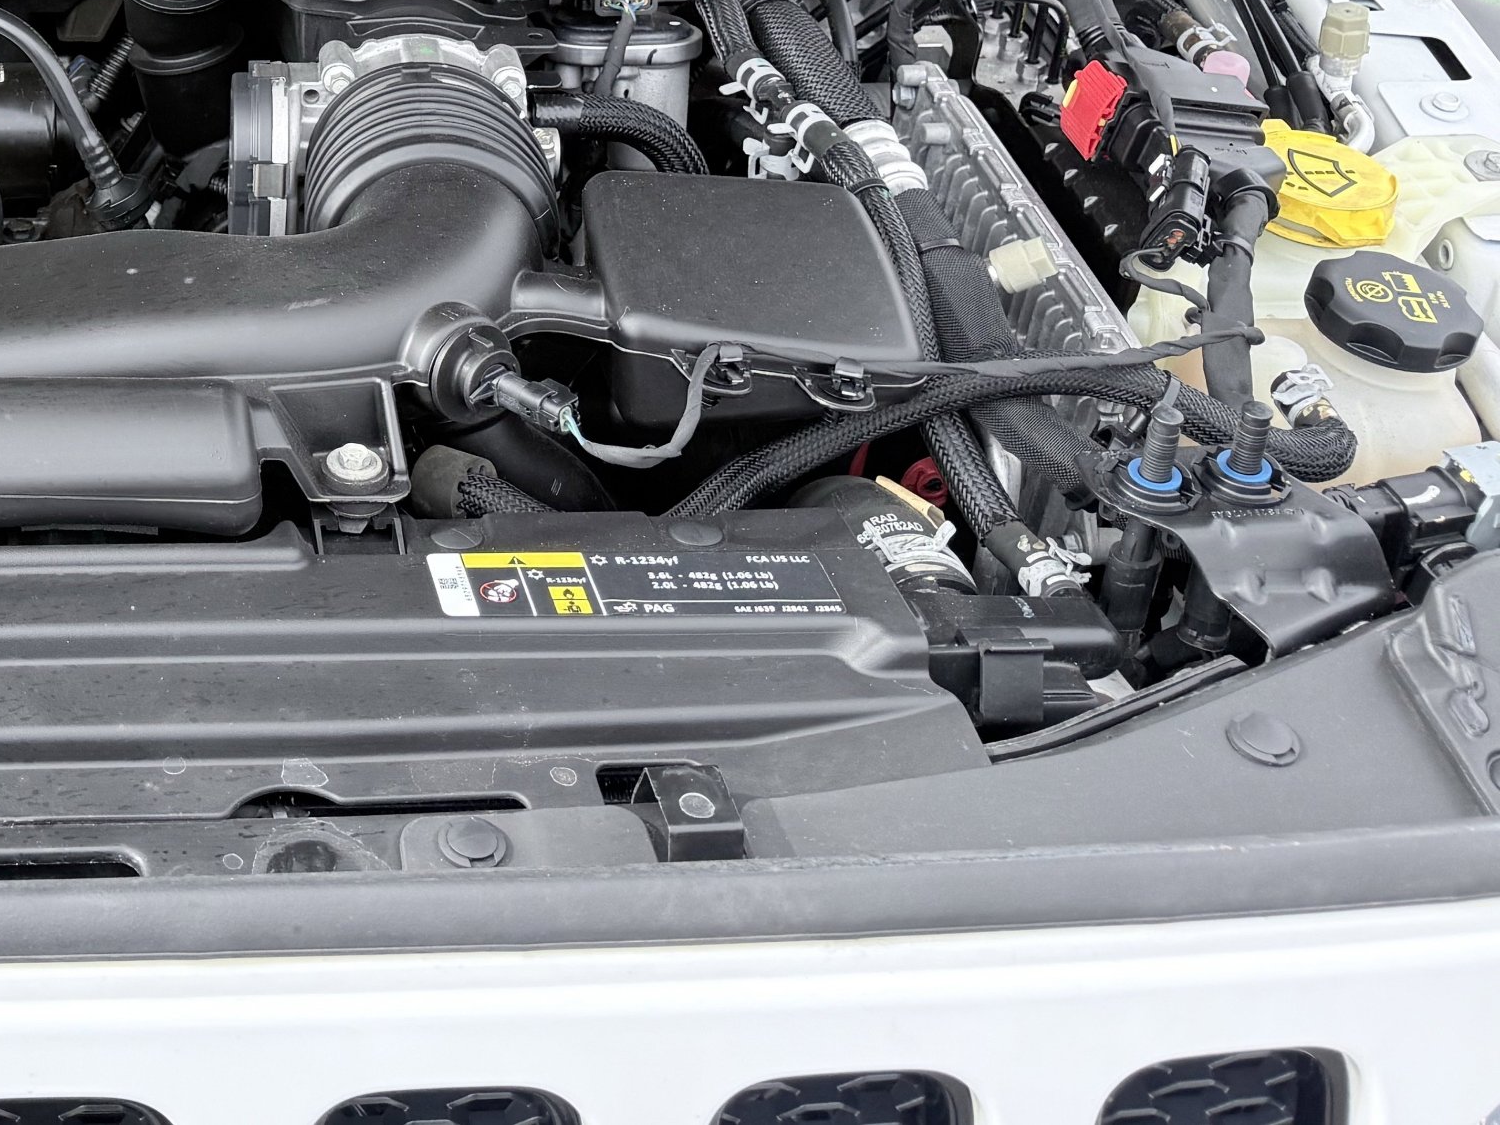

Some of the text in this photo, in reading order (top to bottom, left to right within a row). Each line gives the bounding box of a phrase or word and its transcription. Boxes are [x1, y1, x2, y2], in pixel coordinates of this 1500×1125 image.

[870, 513, 898, 526] RAD
[614, 555, 679, 566] R-1234yf
[746, 555, 811, 563] FCA US LLC
[643, 603, 675, 613] PAG
